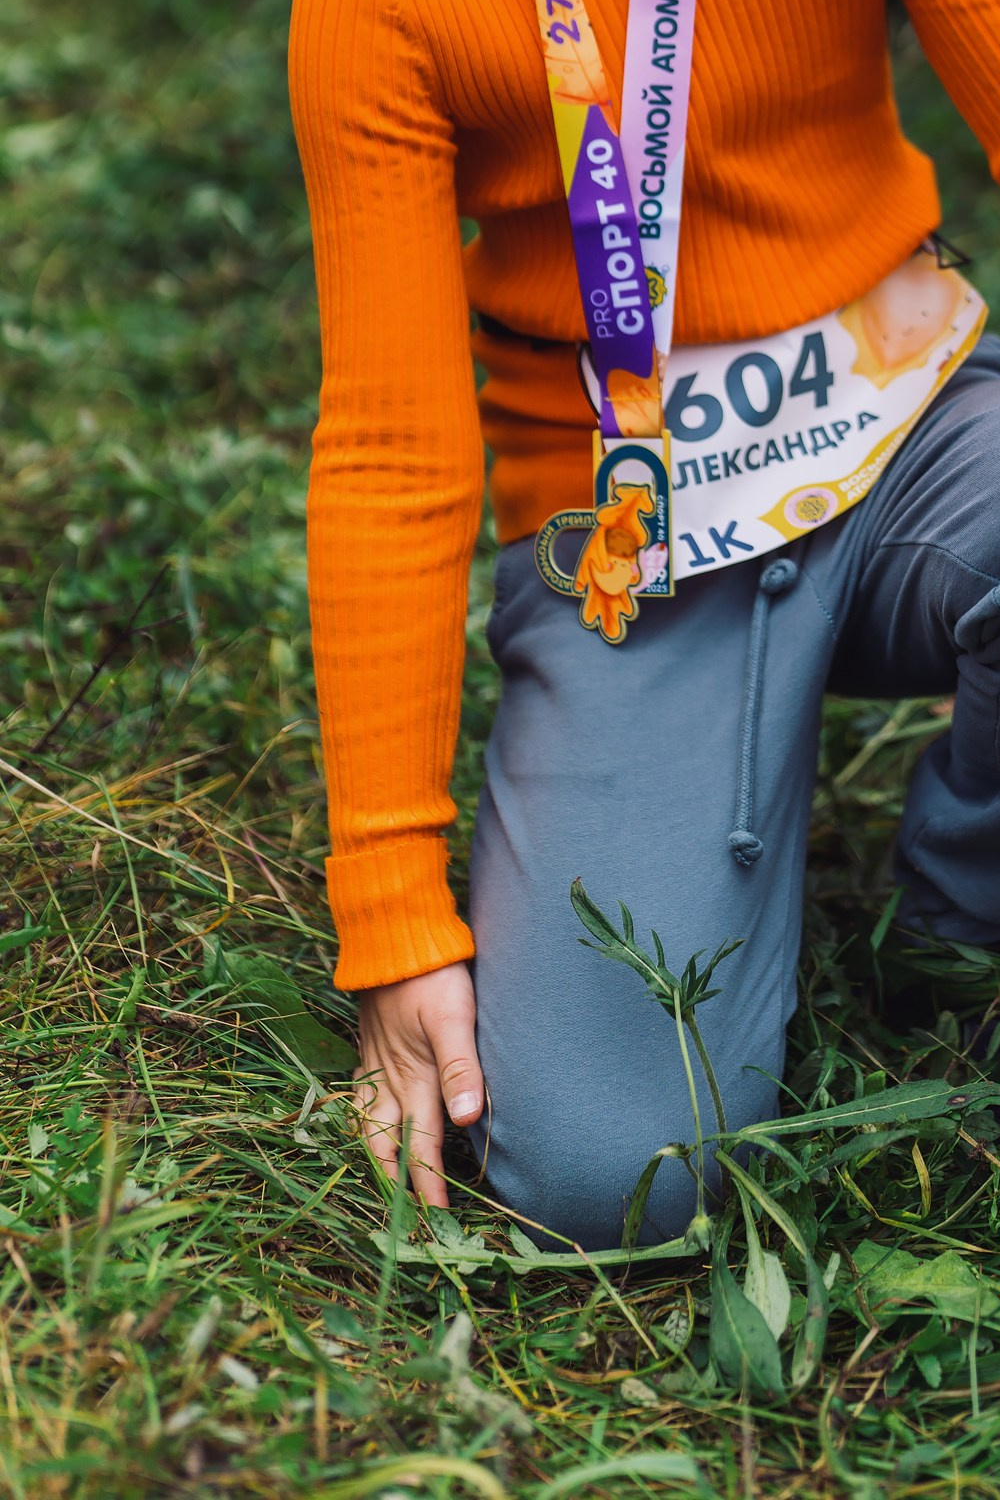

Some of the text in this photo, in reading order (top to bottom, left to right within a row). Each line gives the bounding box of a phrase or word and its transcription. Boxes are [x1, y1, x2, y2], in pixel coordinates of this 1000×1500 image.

[638, 84, 674, 240] ВОСЬМОЙ
[586, 138, 645, 336] СПОРТ 40
[590, 288, 615, 339] PRO
[664, 330, 834, 443] 604
[672, 411, 880, 491] ЛЕКСАНДРА
